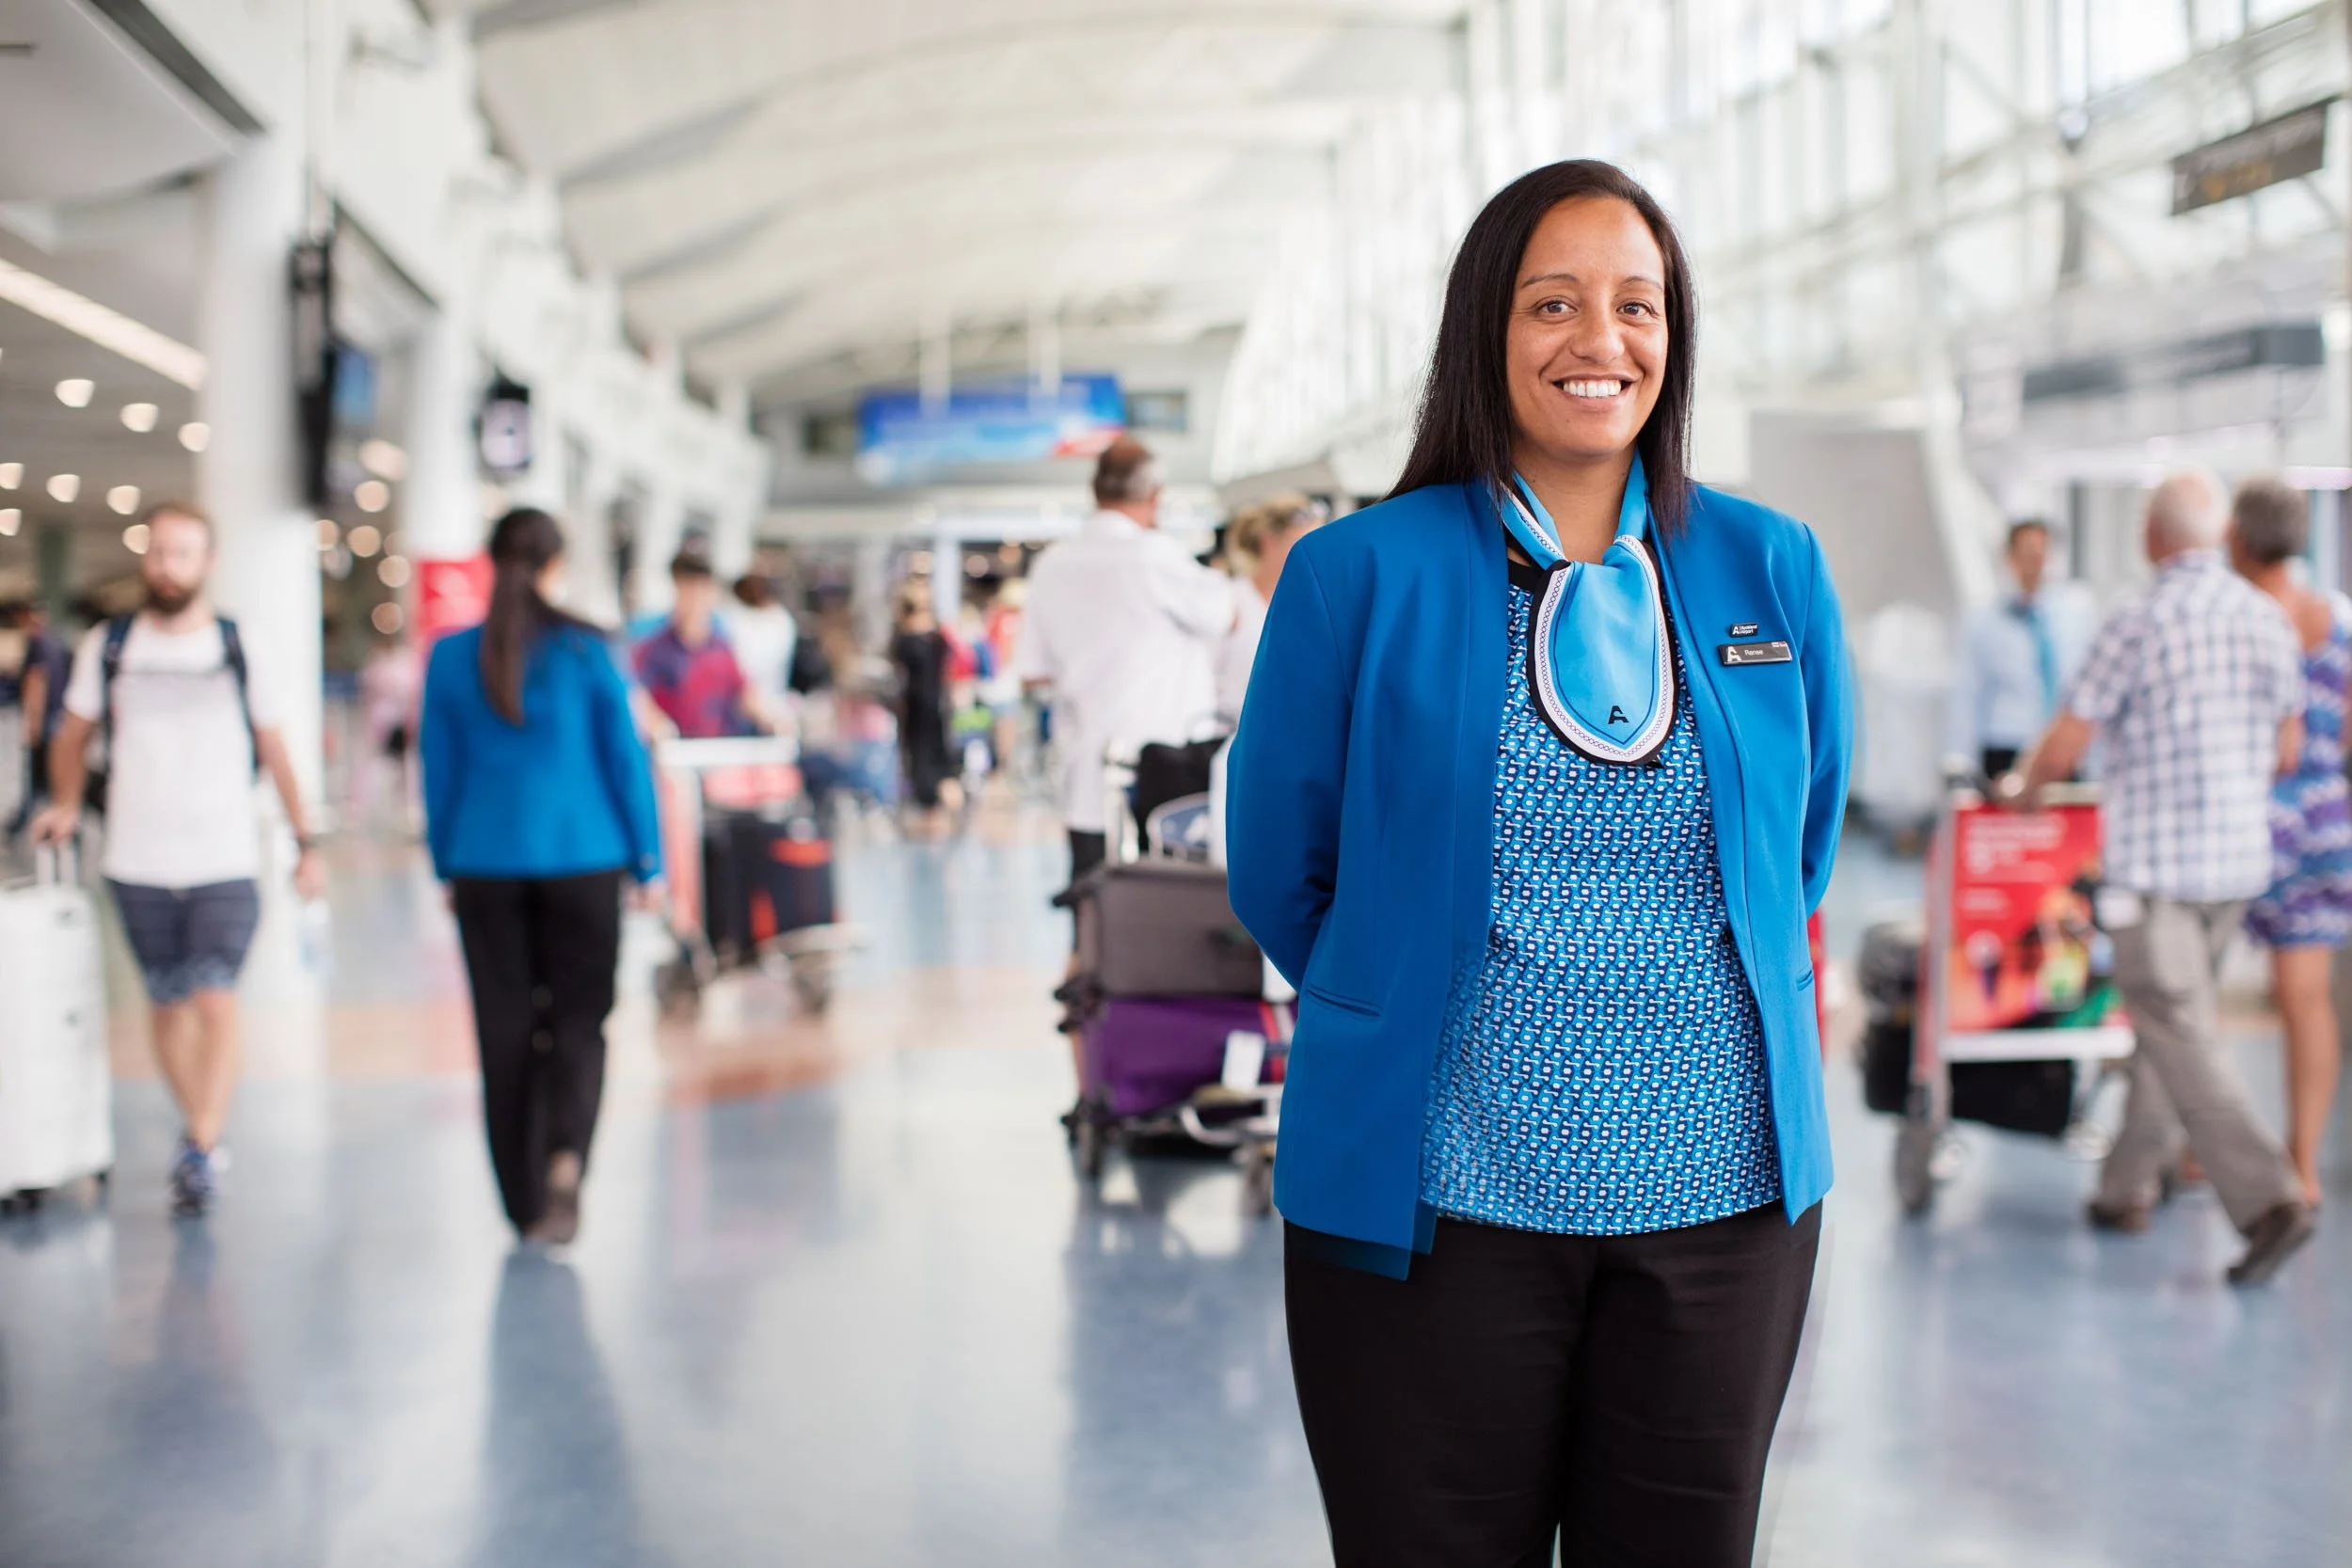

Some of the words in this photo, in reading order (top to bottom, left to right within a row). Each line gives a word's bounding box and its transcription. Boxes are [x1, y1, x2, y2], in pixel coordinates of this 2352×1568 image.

[1732, 626, 1740, 635] A
[1727, 646, 1742, 662] A
[1608, 705, 1629, 724] A
